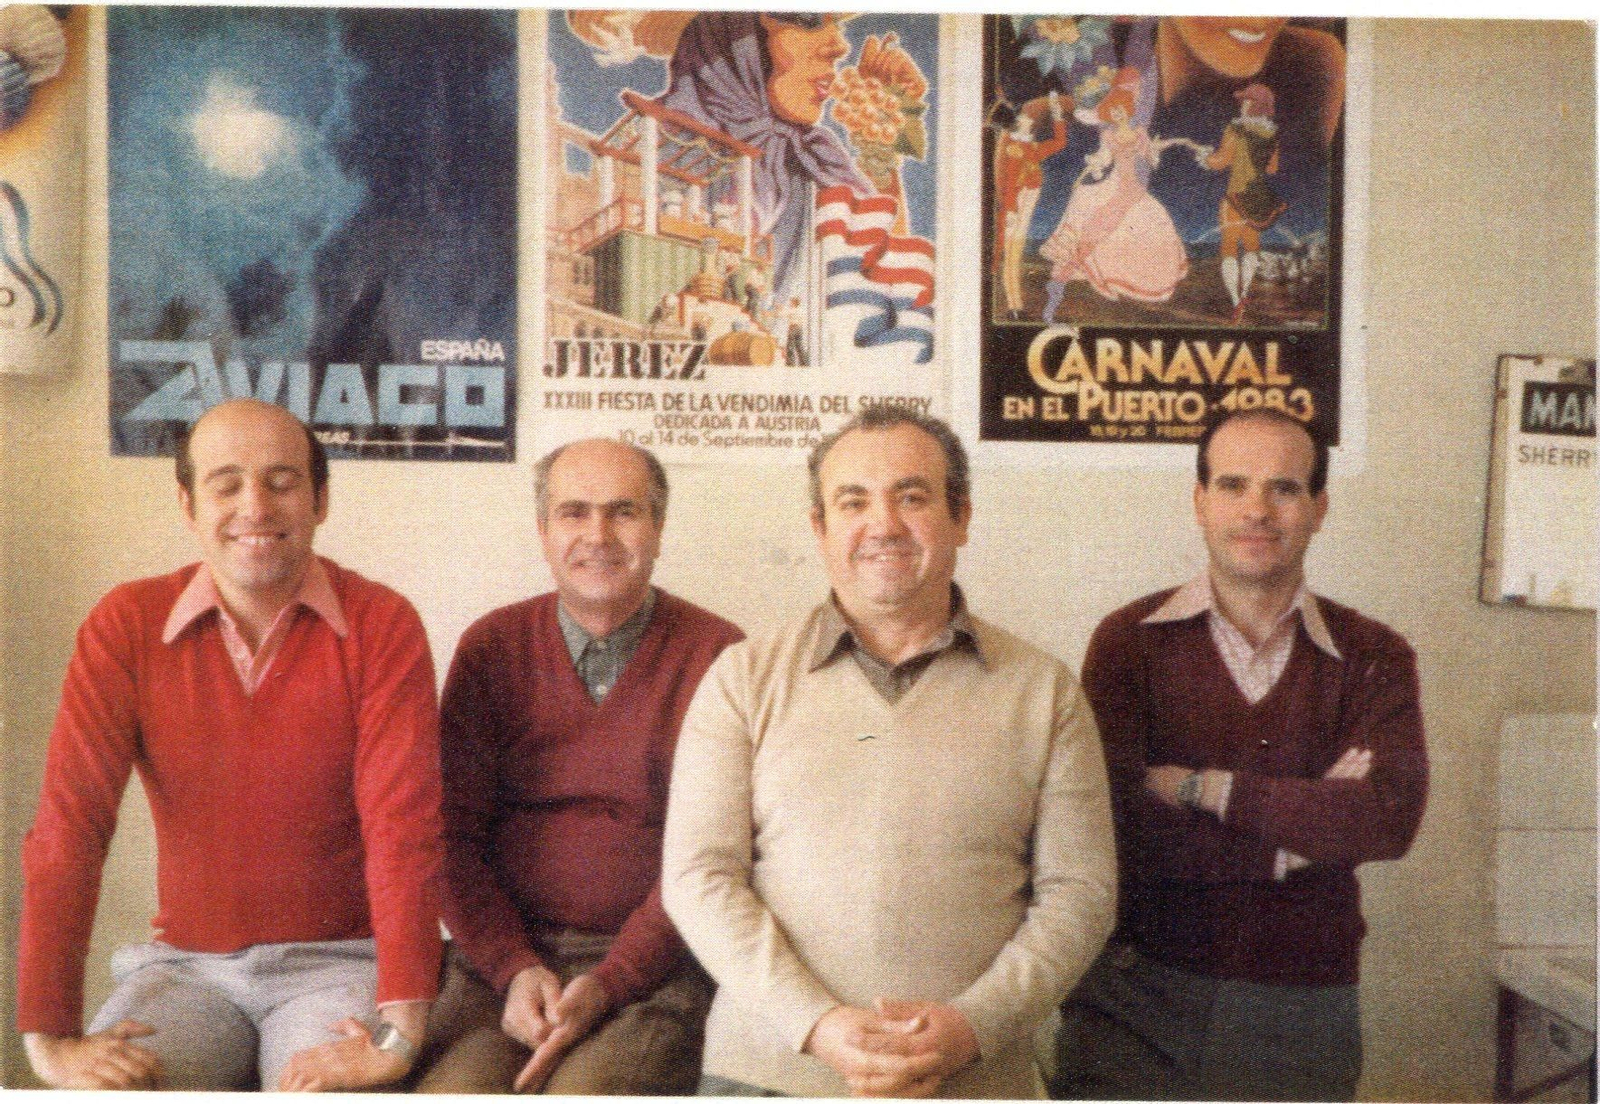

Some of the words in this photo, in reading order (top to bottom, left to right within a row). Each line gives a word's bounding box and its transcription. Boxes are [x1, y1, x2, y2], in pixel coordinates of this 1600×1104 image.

[421, 338, 506, 361] ESPAÑA
[542, 340, 708, 380] JEREZ
[1026, 325, 1293, 394] CARNAVAL
[543, 392, 593, 411] XXXIII
[597, 393, 656, 412] FIESTA
[662, 393, 690, 412] DE
[691, 394, 713, 412] LA
[715, 394, 814, 414] VENDIMIA
[819, 395, 851, 414] DEL
[1003, 397, 1034, 421] EN
[1042, 397, 1070, 421] EL
[1076, 381, 1207, 423] PUERTO
[653, 413, 733, 430] DEDICADA
[738, 415, 750, 430] A
[755, 415, 822, 432] AUSTRIA
[658, 430, 674, 445] 14
[677, 431, 699, 447] de
[702, 430, 794, 449] Septiembre
[1518, 444, 1596, 468] SHERR
